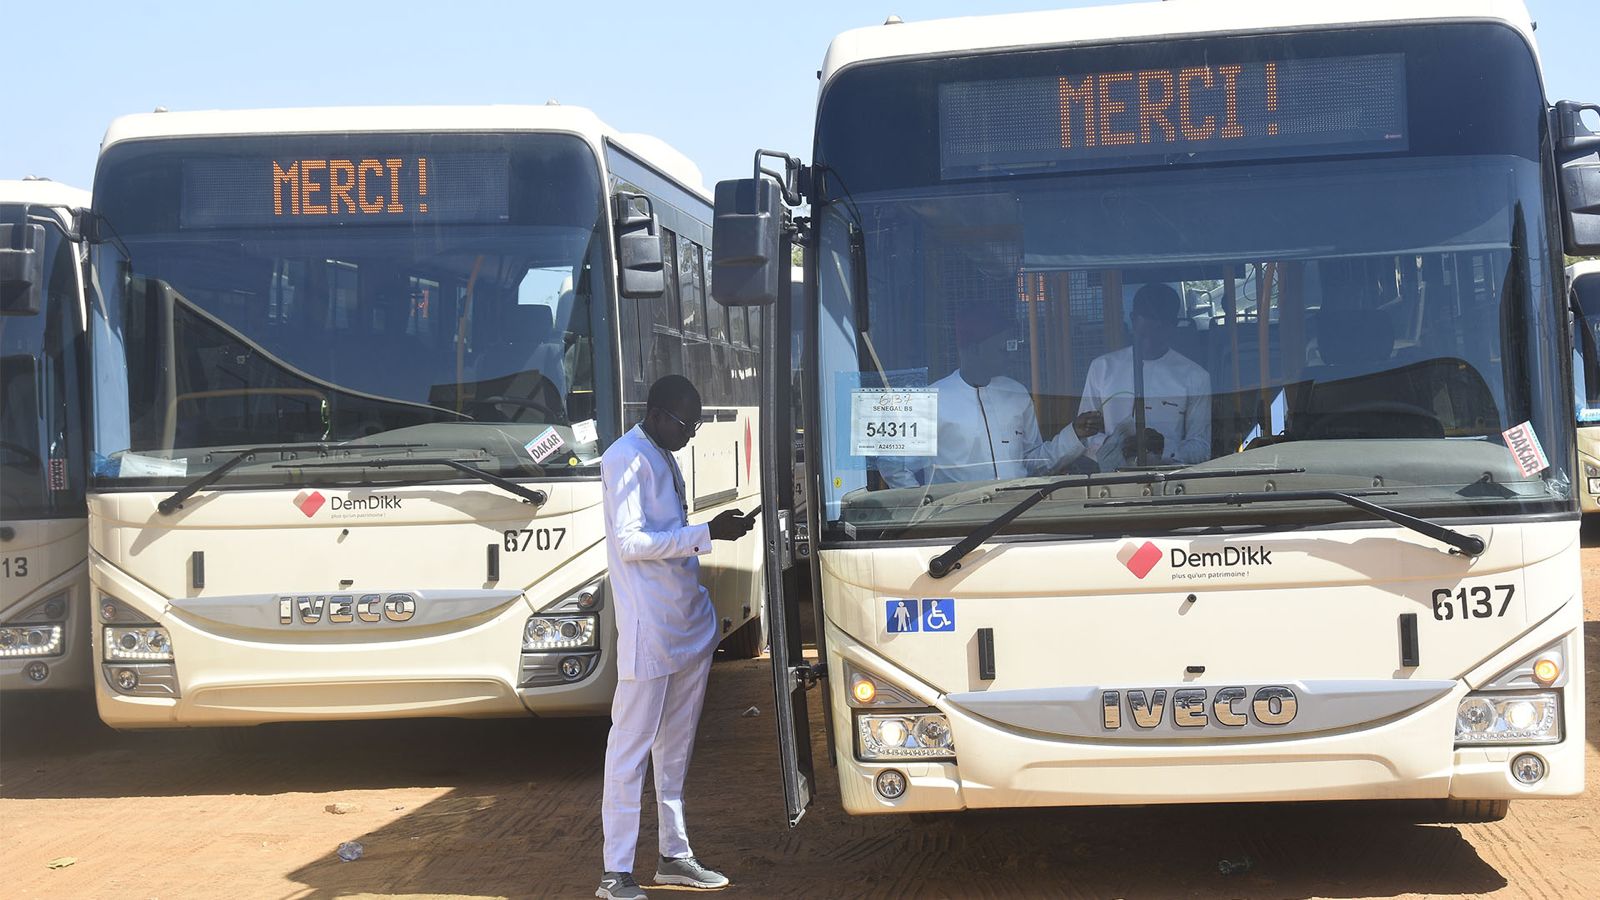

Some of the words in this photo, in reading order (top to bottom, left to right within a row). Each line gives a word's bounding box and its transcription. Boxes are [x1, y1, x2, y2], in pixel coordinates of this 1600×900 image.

[1059, 65, 1244, 148] MERCI
[1266, 63, 1278, 135] !
[273, 158, 404, 215] MERCI
[418, 158, 428, 213] !
[866, 422, 917, 437] 54311
[531, 434, 560, 459] DAKAR
[1508, 428, 1539, 472] DAKAR
[331, 495, 402, 510] DemDikk
[504, 528, 566, 552] 6707
[1171, 545, 1272, 568] DemDikk
[1187, 572, 1206, 580] qu'un
[1208, 571, 1245, 579] patrimoine
[279, 593, 416, 625] IVECO
[1432, 584, 1515, 621] 6137
[1102, 686, 1298, 729] IVECO
